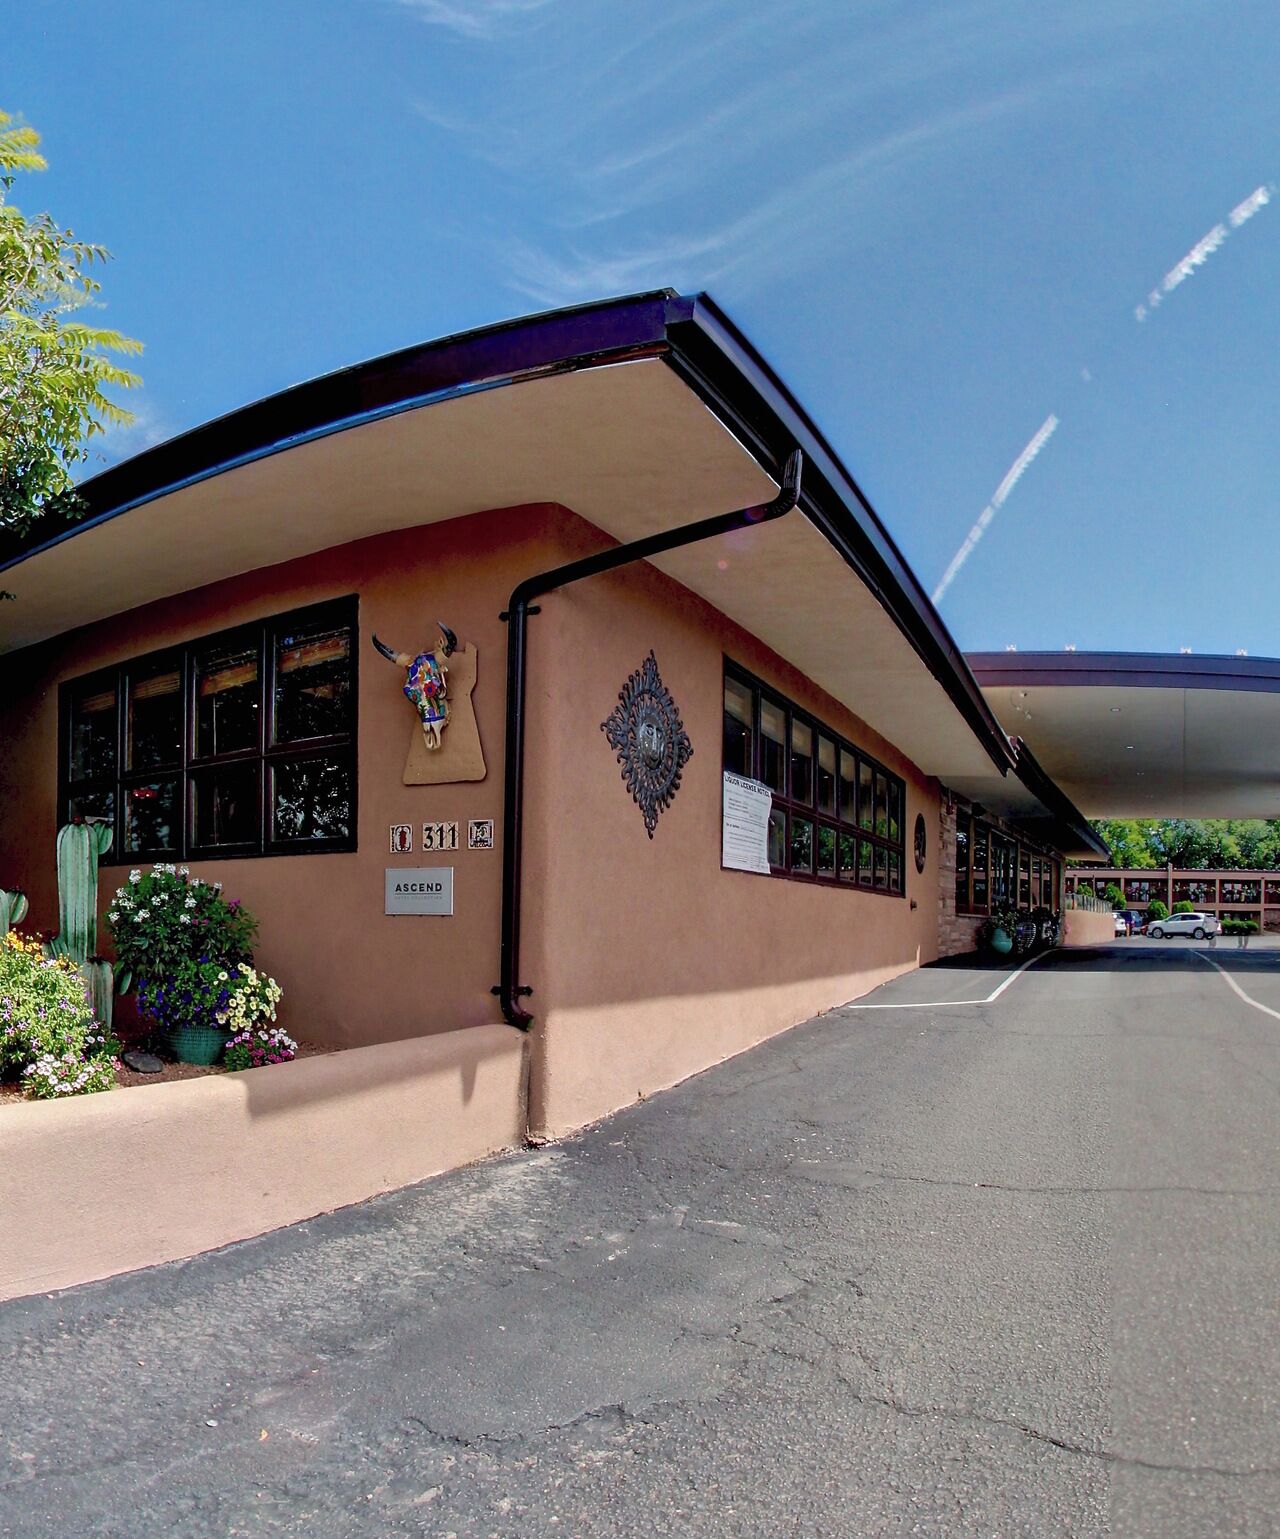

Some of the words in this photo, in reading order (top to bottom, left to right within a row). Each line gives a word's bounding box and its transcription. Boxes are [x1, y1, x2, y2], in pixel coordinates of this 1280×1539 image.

[725, 776, 740, 786] LIQUOR
[740, 782, 757, 792] LICENSE
[424, 824, 455, 848] 311
[395, 883, 442, 892] ASCEND
